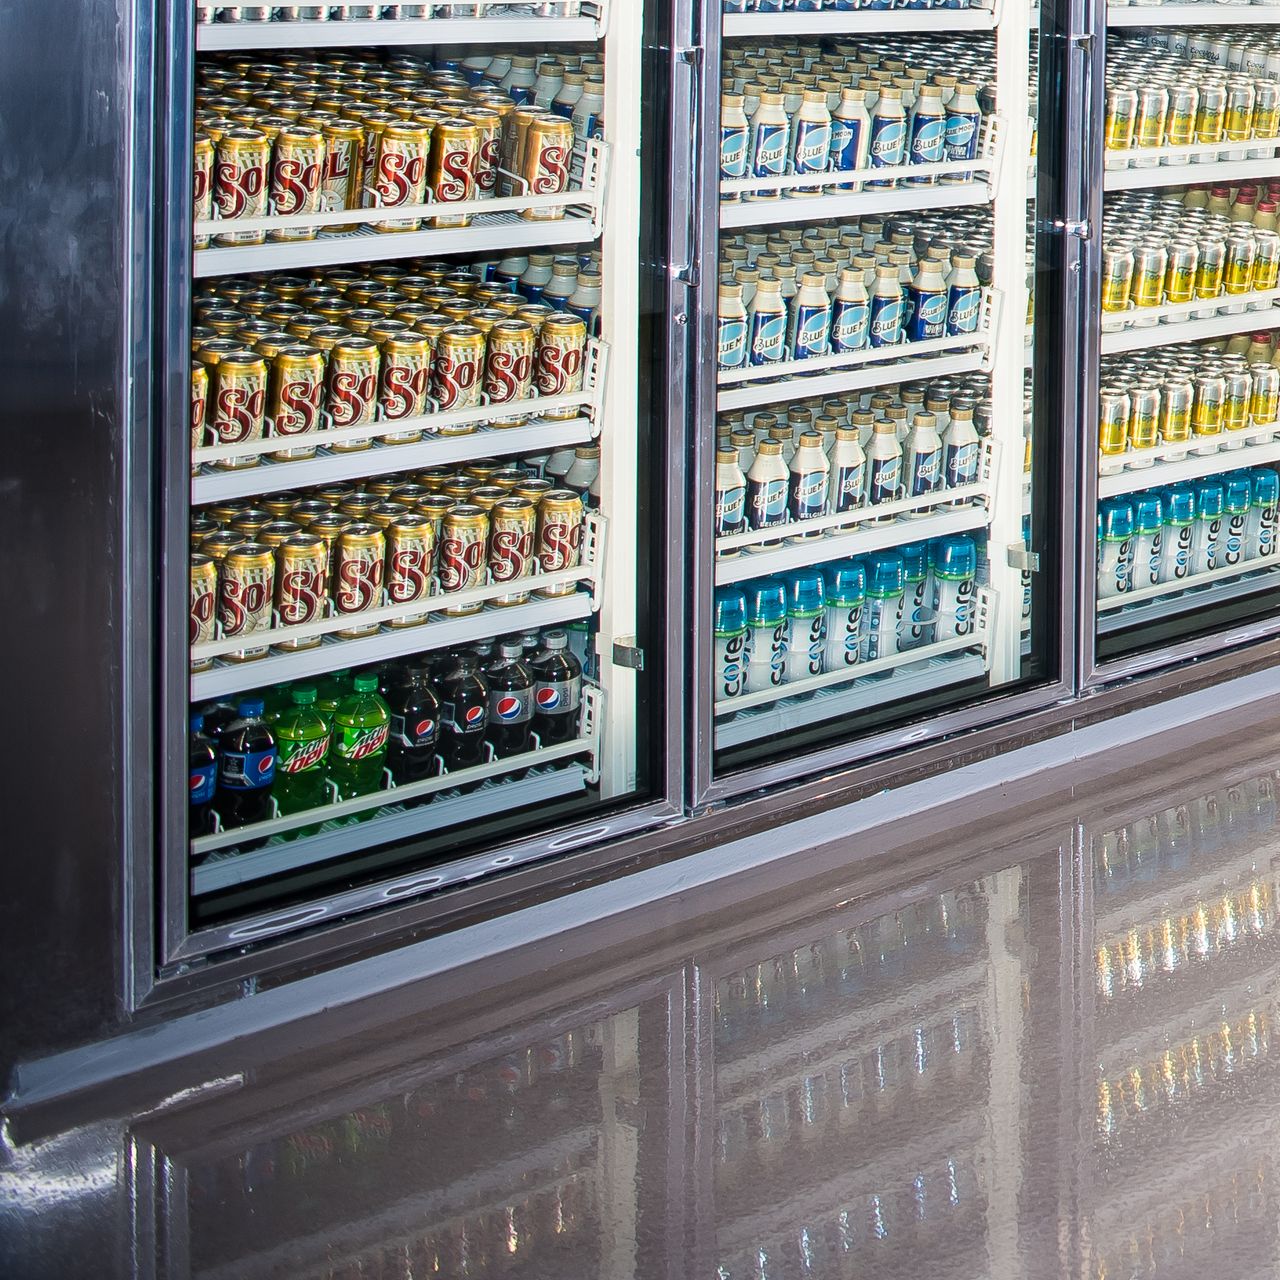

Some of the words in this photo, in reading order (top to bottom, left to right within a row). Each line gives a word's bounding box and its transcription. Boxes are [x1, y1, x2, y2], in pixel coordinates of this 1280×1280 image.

[872, 140, 898, 157] BLUE
[914, 135, 941, 153] BLUE
[754, 334, 781, 353] BLUE
[833, 322, 856, 339] BLUE
[872, 317, 898, 335] BLUE
[1174, 524, 1192, 580] core
[1225, 514, 1245, 566] core
[1258, 505, 1275, 557] core
[1115, 538, 1131, 593] core
[955, 578, 974, 637] core
[844, 605, 863, 666] core
[723, 635, 743, 698] core
